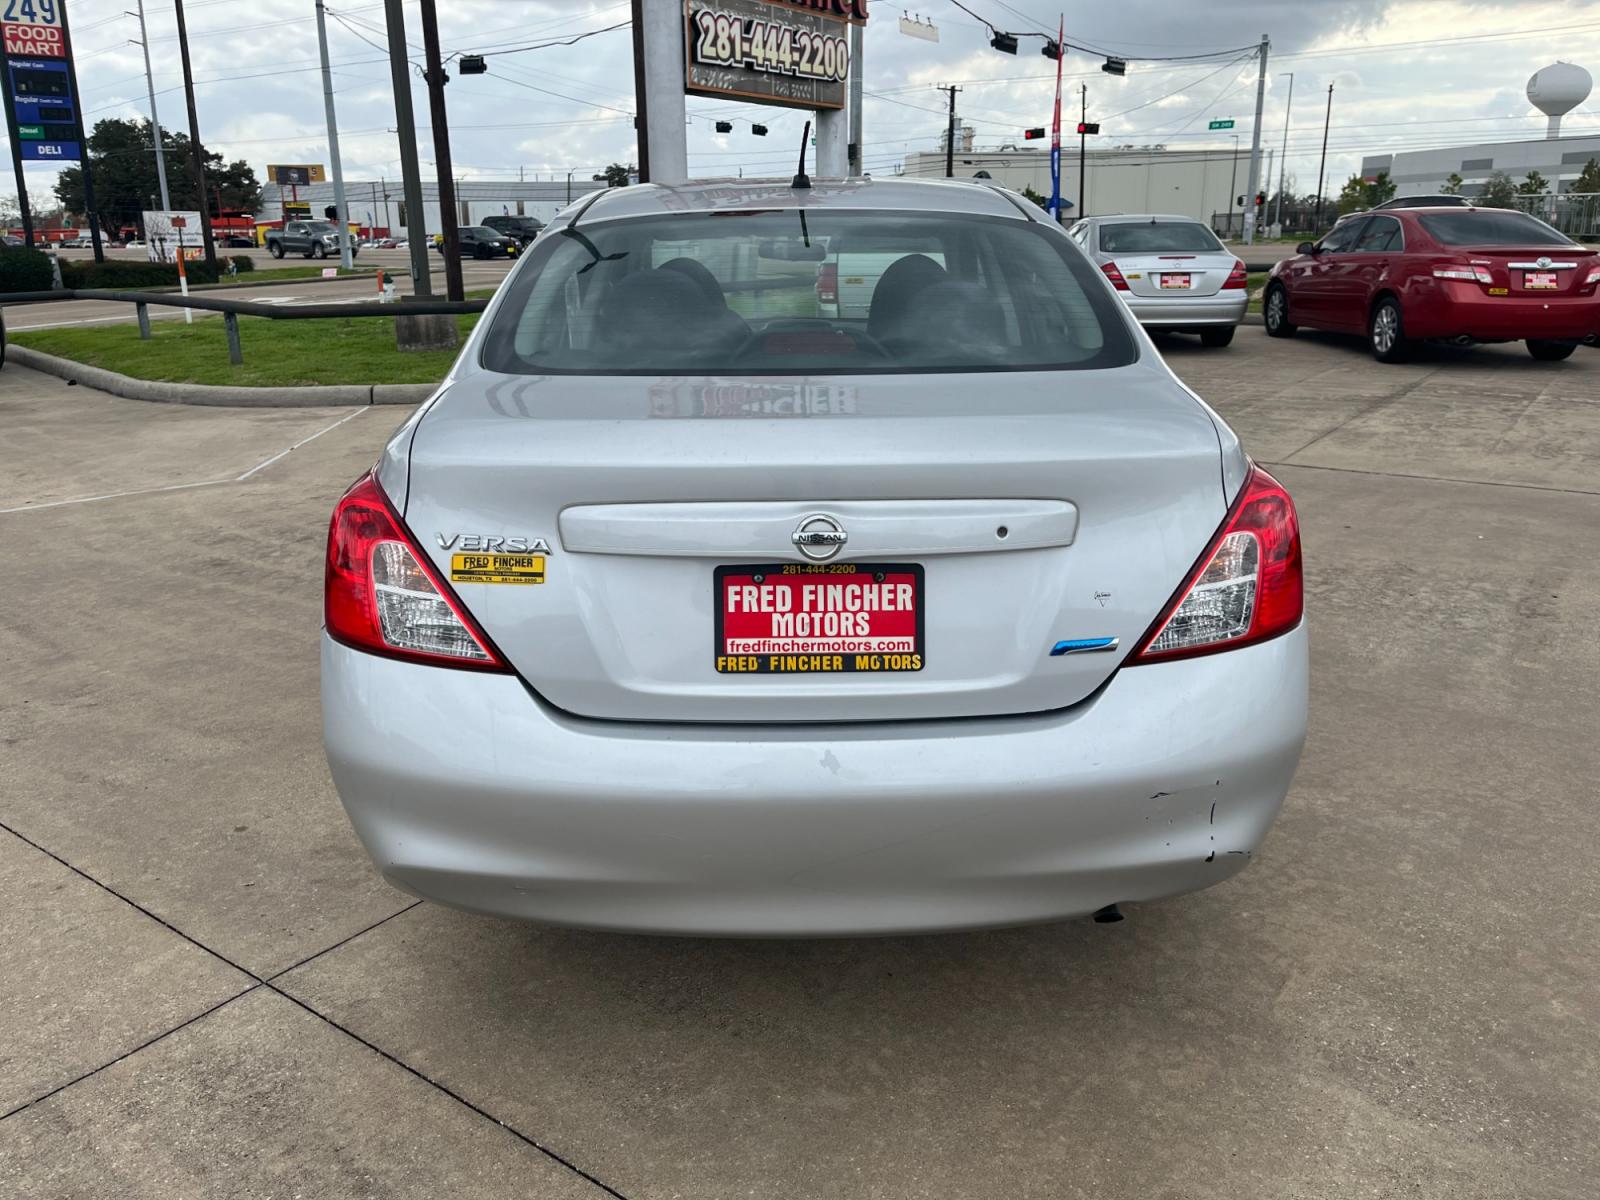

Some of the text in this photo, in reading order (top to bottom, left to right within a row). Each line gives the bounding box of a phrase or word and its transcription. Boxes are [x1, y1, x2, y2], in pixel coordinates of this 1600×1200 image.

[5, 25, 59, 42] FOOD
[6, 39, 61, 56] MART
[698, 10, 849, 82] 281-444-2200
[37, 145, 62, 155] DELI
[436, 532, 553, 556] VERSA
[798, 533, 842, 544] NISSAN
[463, 556, 533, 569] FRED FINCHER
[782, 564, 856, 574] 281-444-2200
[727, 583, 913, 613] FRED FINCHER
[771, 612, 870, 637] MOTORS
[729, 639, 911, 653] fredfinchermotors.com
[717, 655, 922, 671] FRED FINCHER MOTORS
